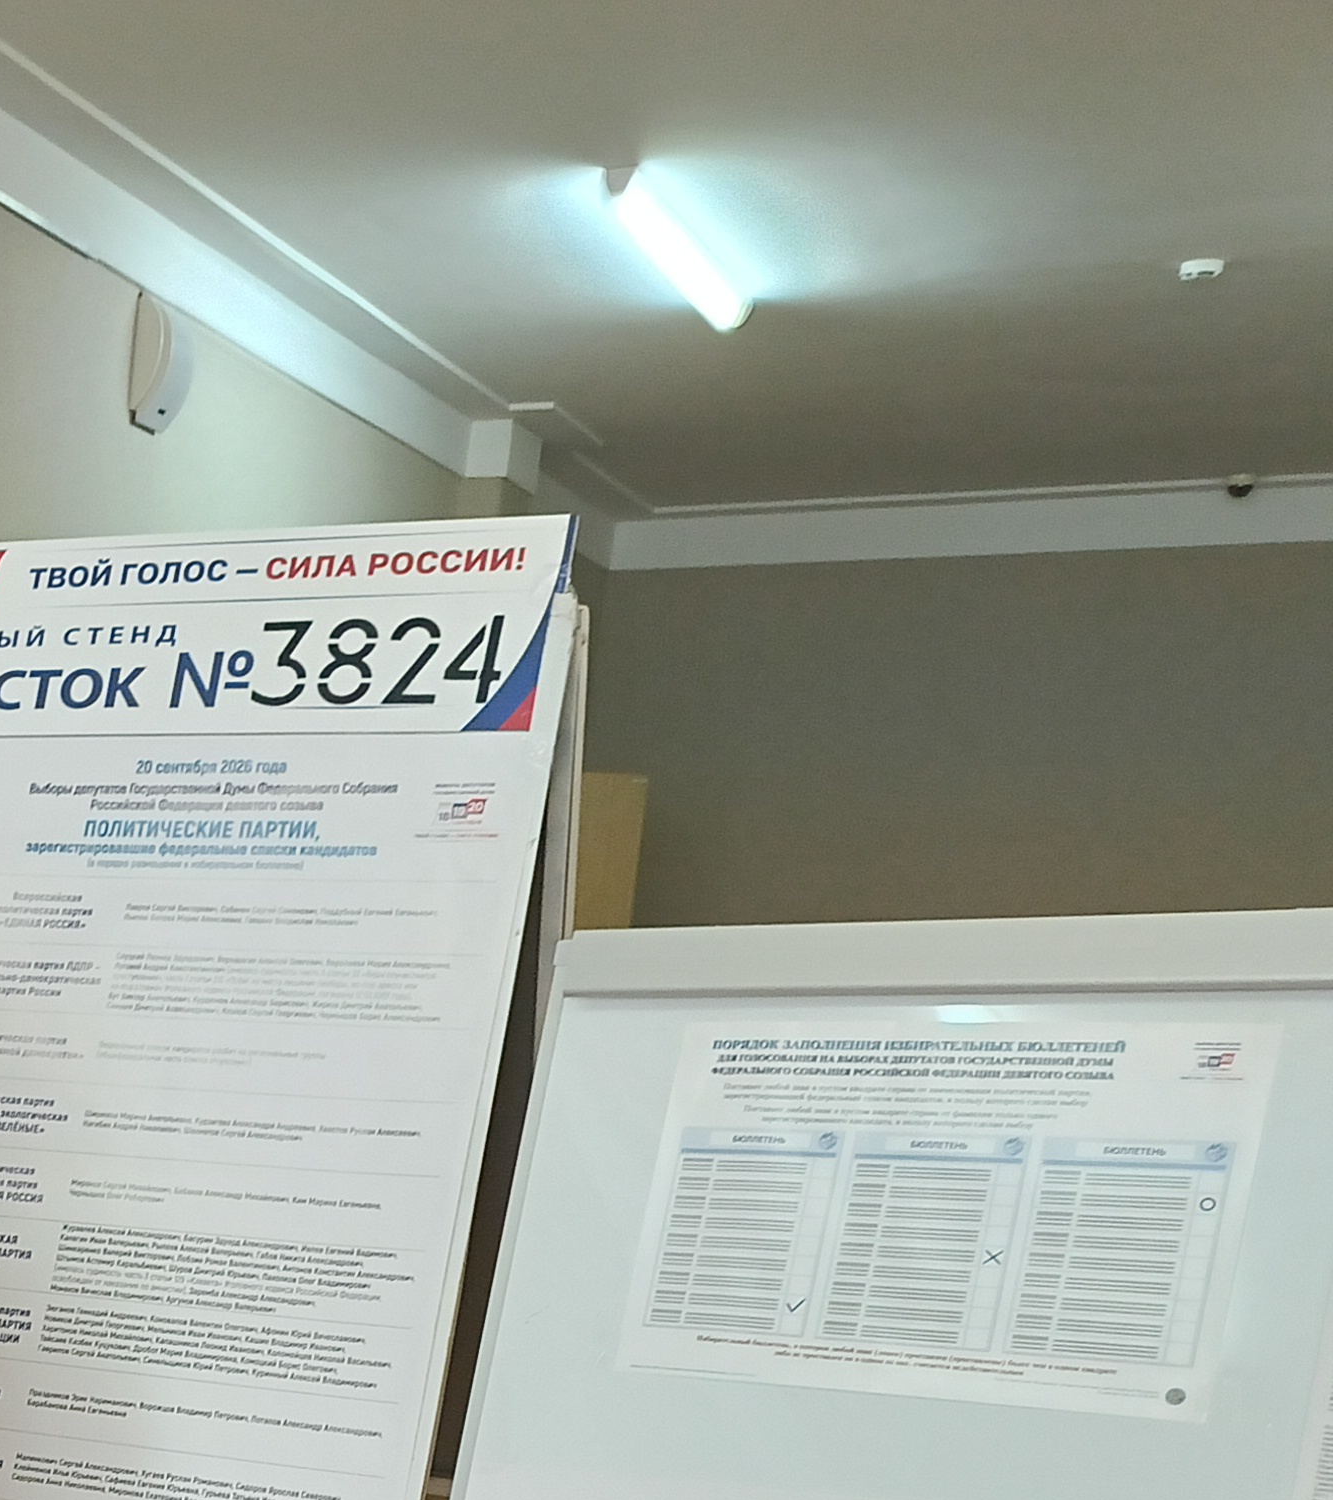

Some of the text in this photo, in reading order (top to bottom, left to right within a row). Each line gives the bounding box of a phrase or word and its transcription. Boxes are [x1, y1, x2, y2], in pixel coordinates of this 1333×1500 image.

[30, 547, 526, 589] ТВОЙ ГОЛОС СИЛА РОССИИ!
[64, 624, 178, 648] СТЕНД
[136, 760, 287, 775] 20 сентября 2026 года
[29, 783, 73, 795] Выборы
[222, 783, 255, 797] Думы
[342, 782, 398, 796] Собрания
[83, 819, 321, 842] ПОЛИТИЧЕСКИЕ ПАРТИИ,
